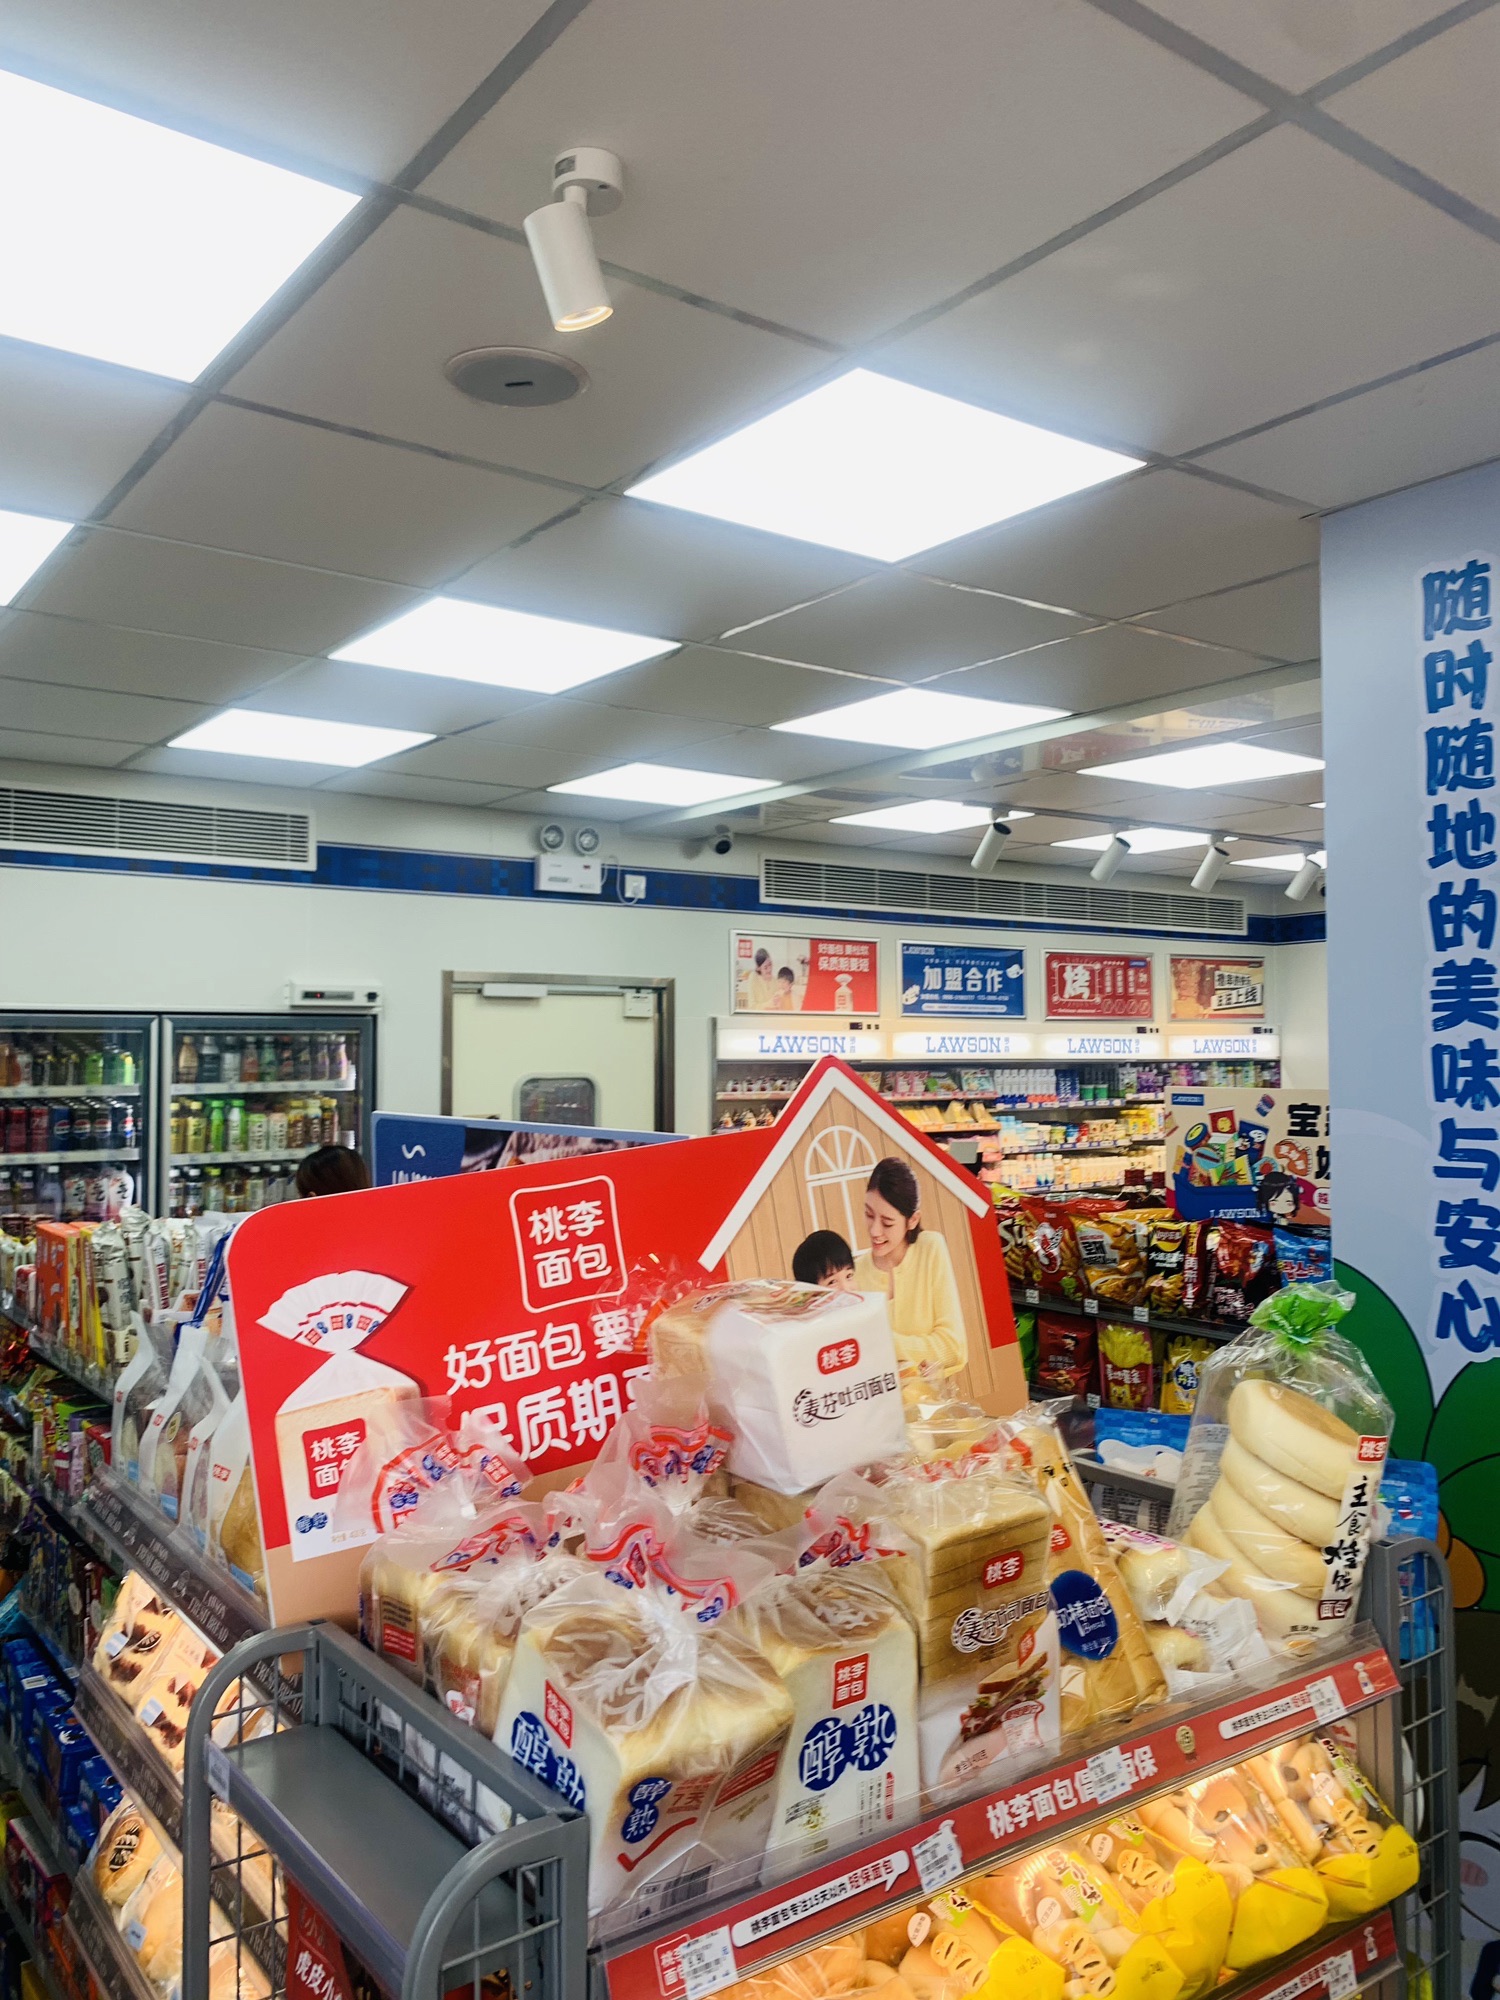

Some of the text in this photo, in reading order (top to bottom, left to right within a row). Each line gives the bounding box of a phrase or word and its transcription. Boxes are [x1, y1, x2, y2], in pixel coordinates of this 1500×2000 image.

[818, 956, 870, 972] 保质期要短
[1423, 560, 1500, 1356] 随时随地的美味与安心
[922, 965, 1004, 993] 加盟合作
[1063, 965, 1091, 999] 烤
[758, 1035, 846, 1054] LAWSON
[926, 1036, 1001, 1054] LAWSON
[1067, 1038, 1133, 1054] LAWSON
[1193, 1039, 1251, 1054] LAWSON
[527, 1199, 606, 1245] 桃李
[533, 1242, 612, 1289] 面包
[443, 1322, 587, 1396] 好面包
[820, 1342, 857, 1370] 桃李
[459, 1365, 653, 1462] 保质期
[793, 1371, 897, 1428] 麦芬吐司面包
[310, 1431, 362, 1462] 桃李
[985, 1557, 1021, 1584] 桃李
[1320, 1600, 1348, 1618] 面包
[836, 1662, 868, 1682] 桃李
[836, 1680, 867, 1701] 面包
[800, 1704, 898, 1787] 醇熟
